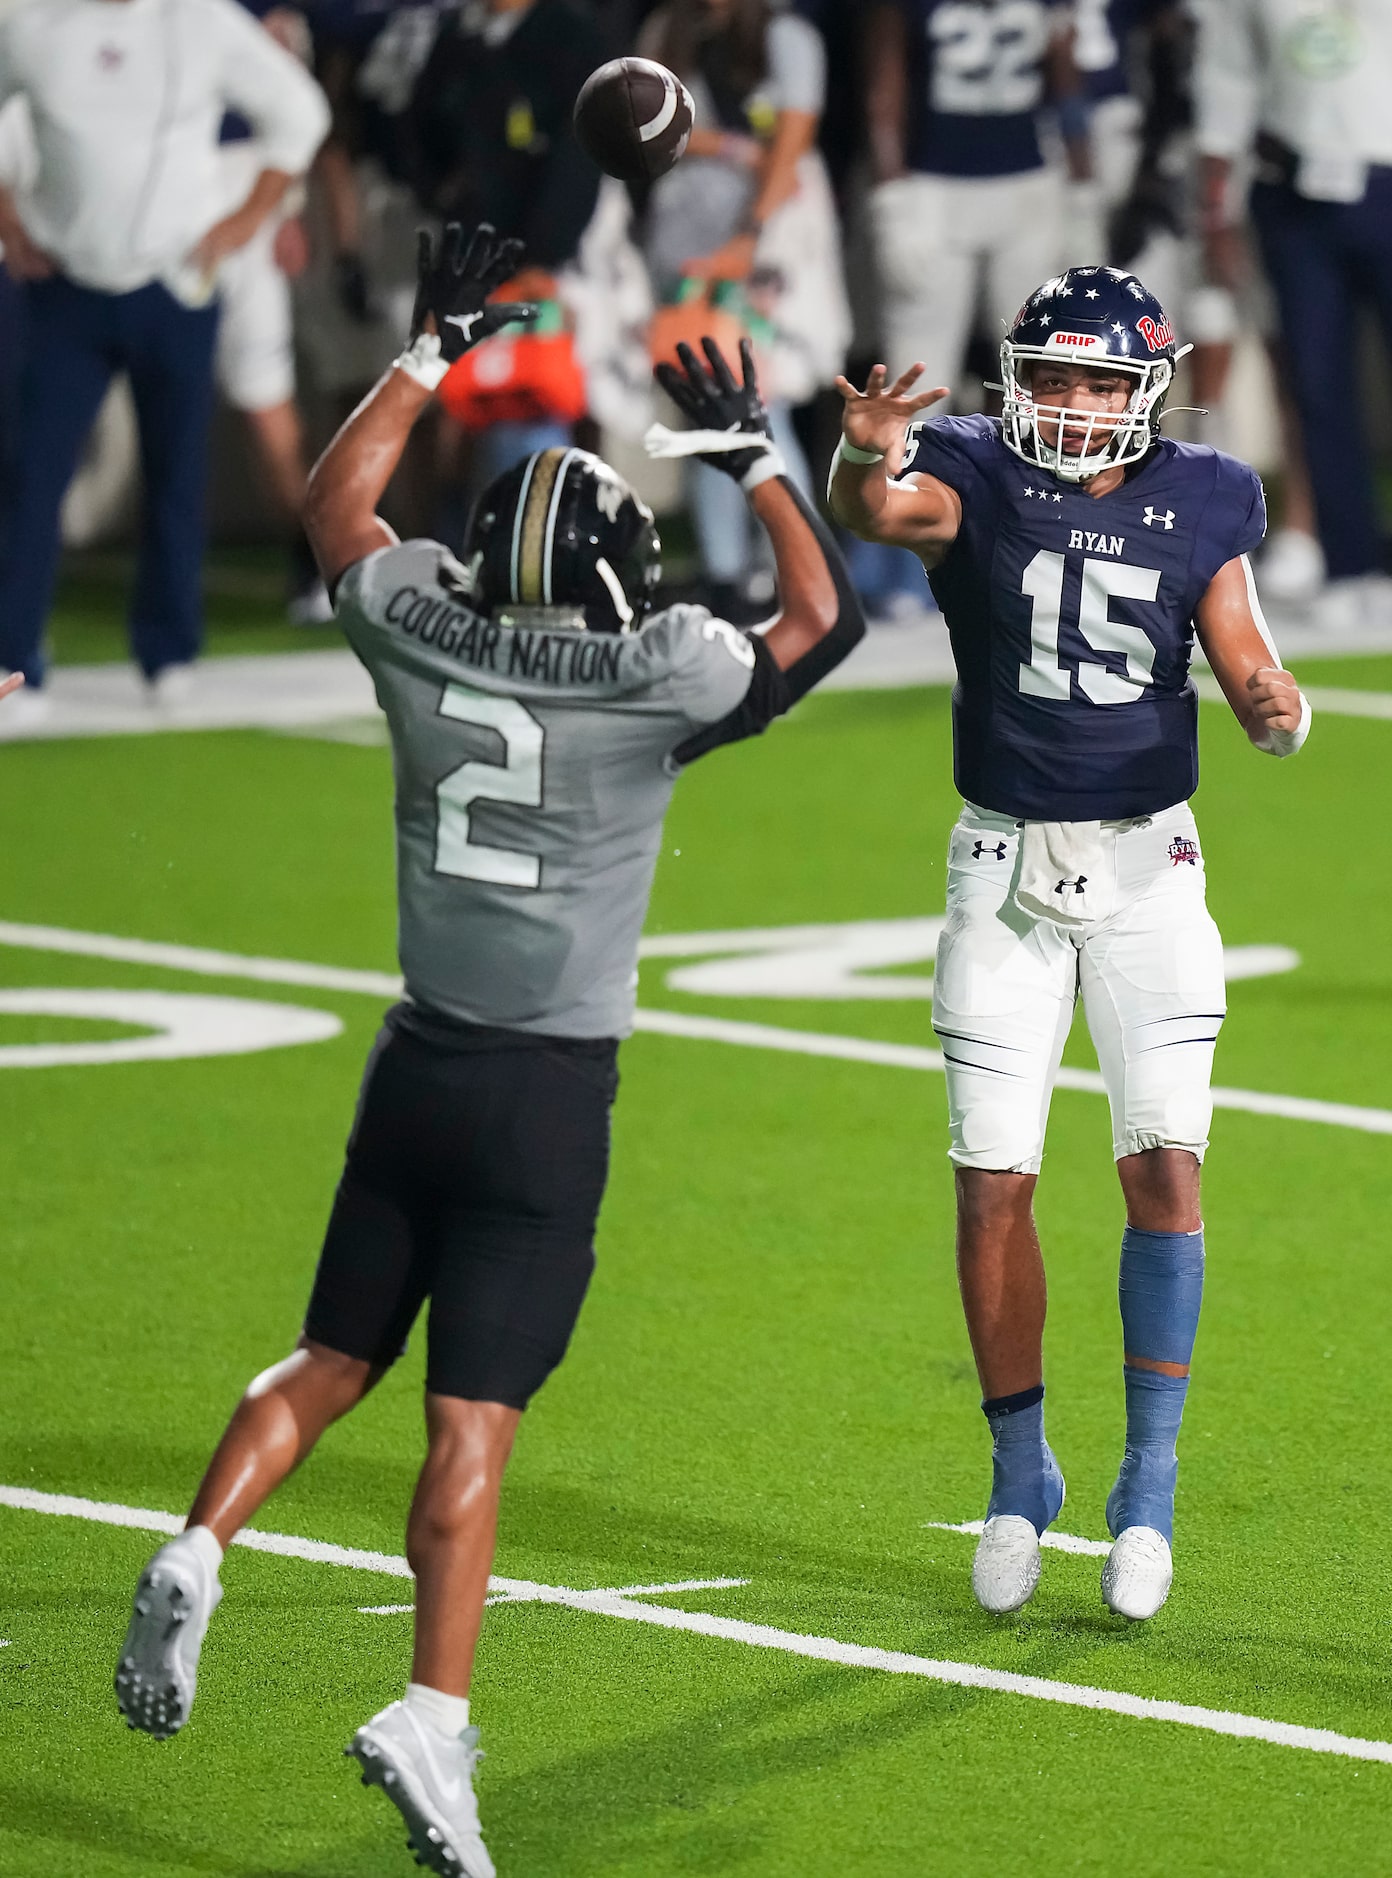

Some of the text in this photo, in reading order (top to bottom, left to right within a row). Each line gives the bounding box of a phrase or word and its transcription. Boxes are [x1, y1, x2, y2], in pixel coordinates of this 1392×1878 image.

[928, 2, 1048, 115] 22
[1055, 333, 1096, 347] DRIP
[904, 421, 927, 469] 5
[1068, 529, 1125, 557] RYAN
[385, 586, 624, 684] COUGAR NATION
[702, 615, 757, 671] 2
[1018, 549, 1162, 705] 15
[434, 680, 546, 889] 2
